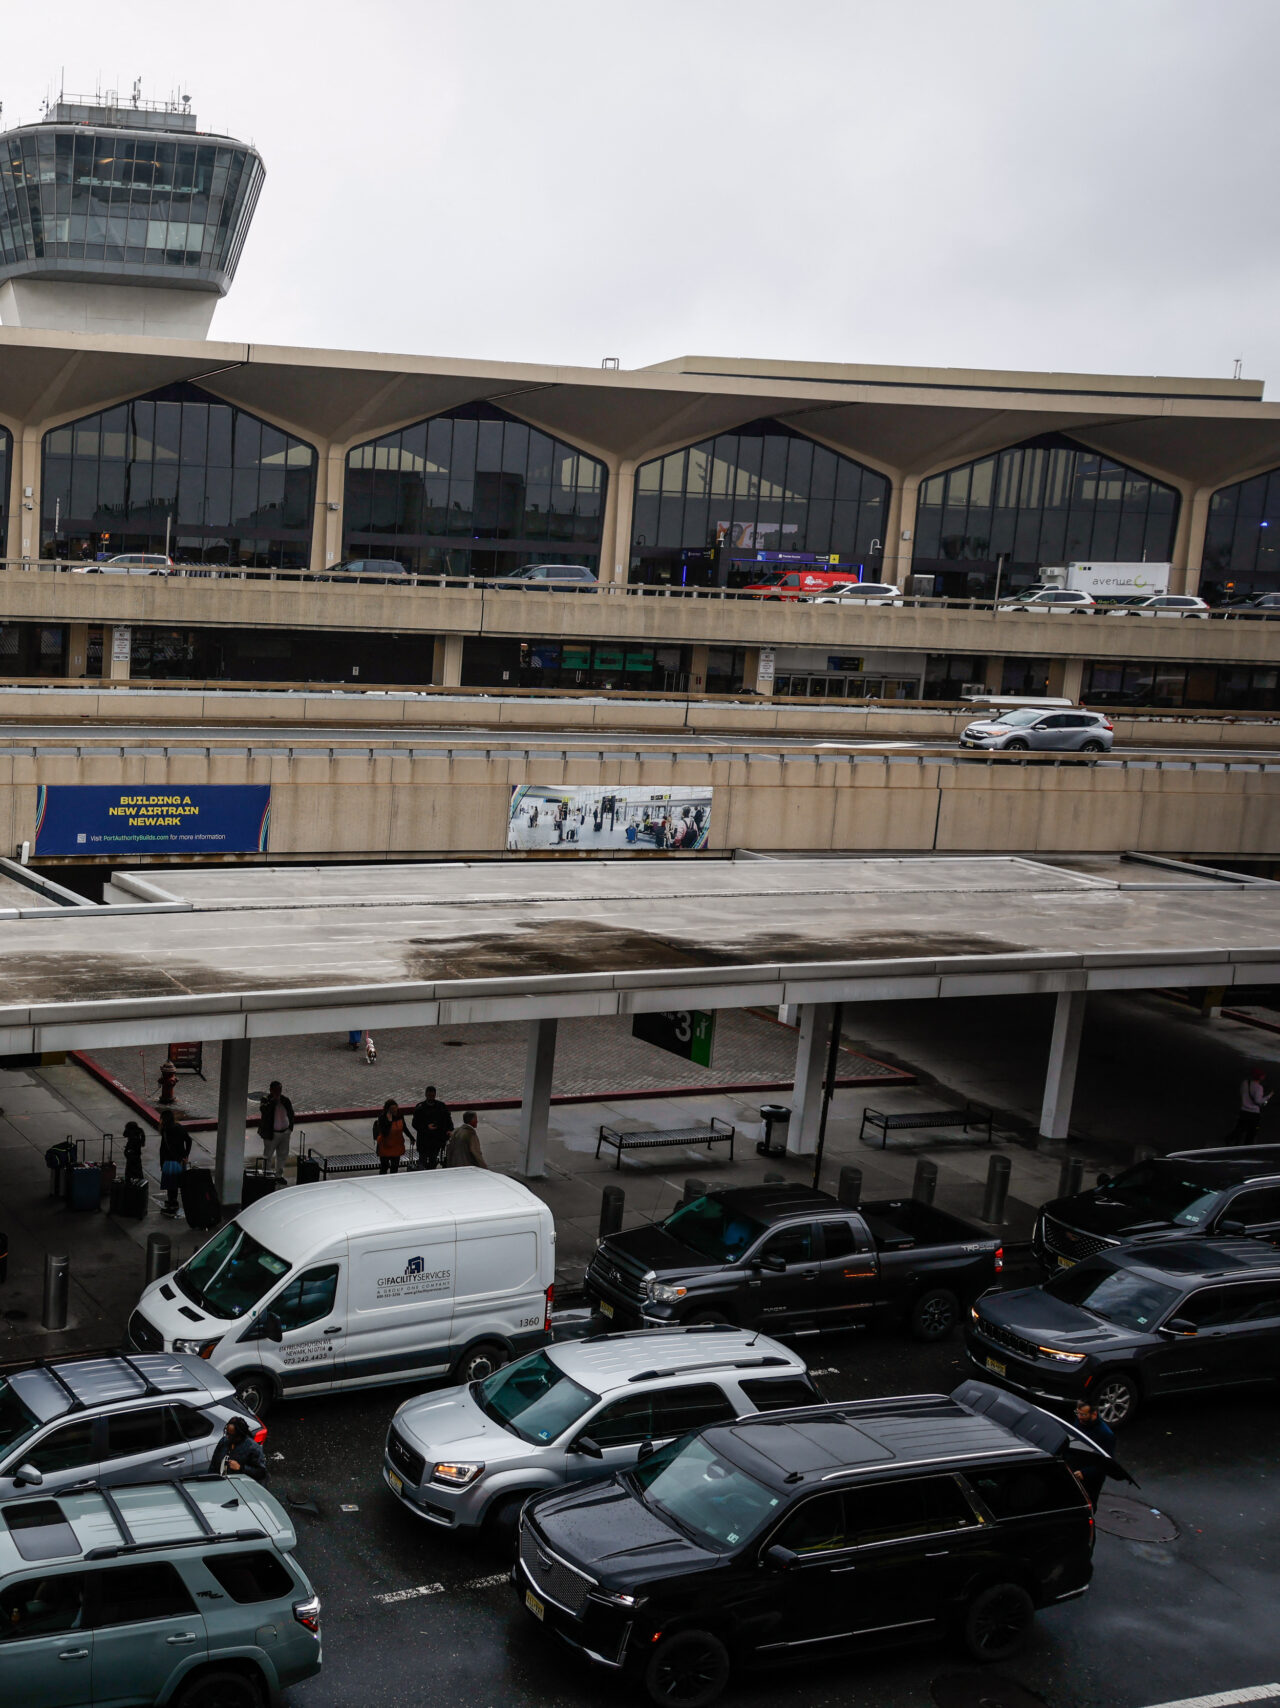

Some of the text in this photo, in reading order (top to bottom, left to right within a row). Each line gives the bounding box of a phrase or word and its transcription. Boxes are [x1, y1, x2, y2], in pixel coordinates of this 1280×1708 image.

[120, 796, 192, 805] BUILDING A
[108, 806, 199, 816] NEW AIRTRAIN
[128, 817, 181, 826] NEWARK
[676, 1011, 692, 1042] 3
[520, 1316, 539, 1327] 1360
[284, 1353, 328, 1365] 973.242.4435
